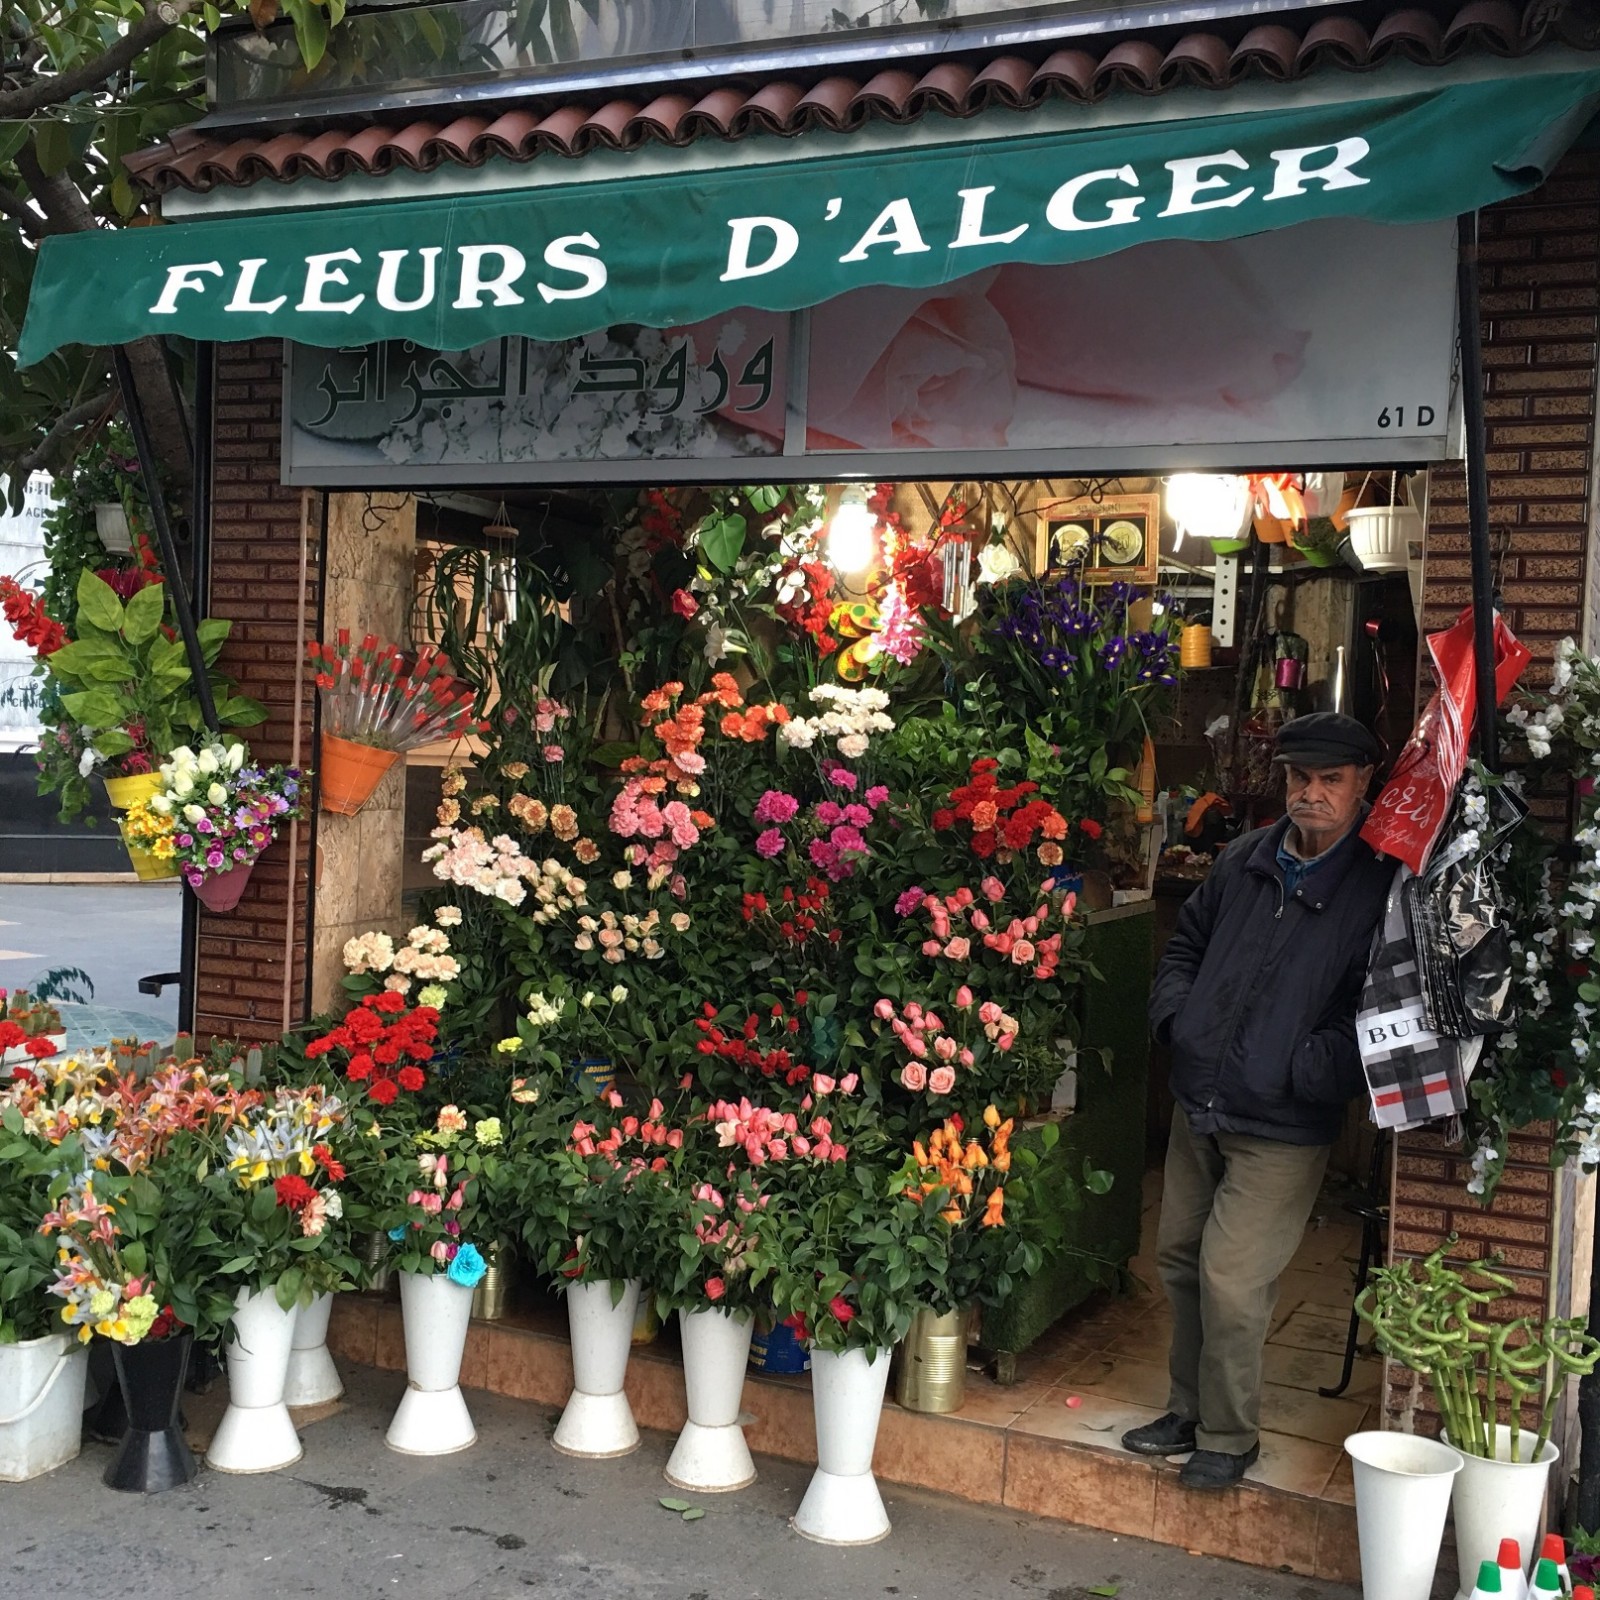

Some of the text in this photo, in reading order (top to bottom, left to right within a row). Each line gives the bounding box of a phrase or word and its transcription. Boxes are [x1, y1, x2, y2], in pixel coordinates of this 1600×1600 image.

[149, 137, 1370, 314] FLEURS D'ALGER
[572, 335, 775, 415] ورود
[1378, 406, 1434, 428] 61 D
